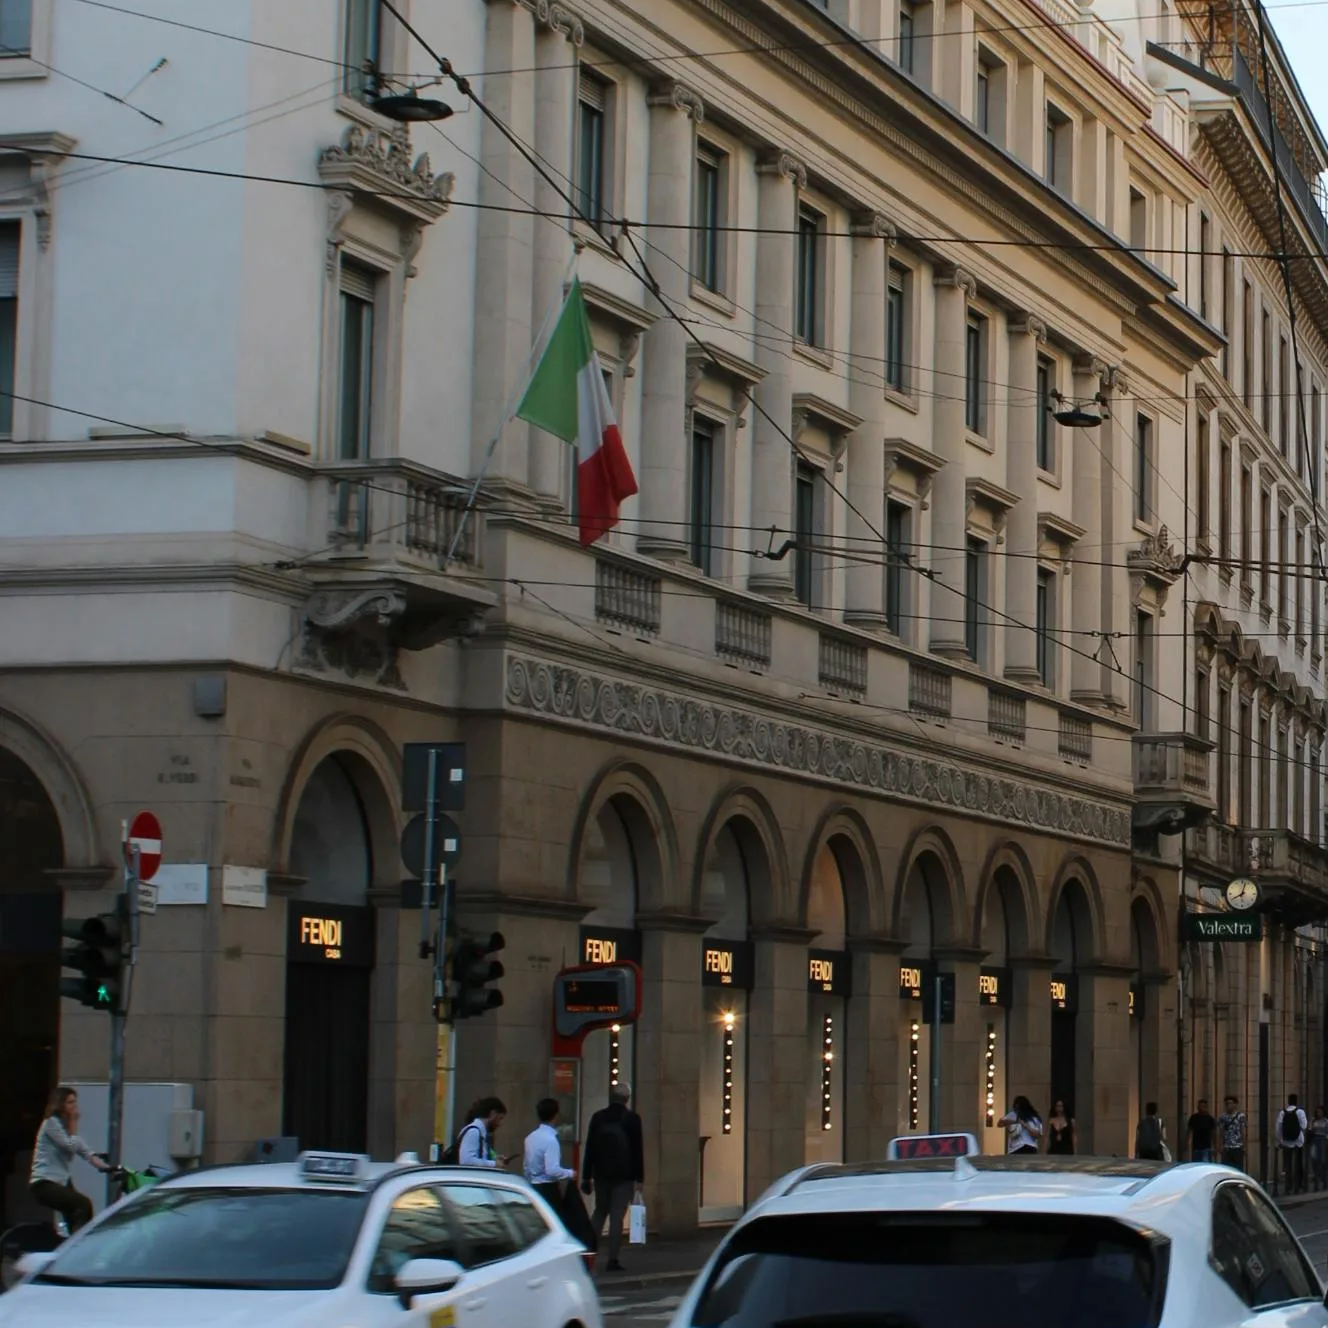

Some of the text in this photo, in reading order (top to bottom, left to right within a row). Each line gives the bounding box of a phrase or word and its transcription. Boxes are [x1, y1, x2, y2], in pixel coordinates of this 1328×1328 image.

[301, 917, 342, 946] FENDI
[1198, 920, 1252, 935] Valextra
[585, 939, 617, 963] FENDI
[706, 950, 733, 973] FENDI
[810, 959, 833, 980] FENDI
[900, 967, 921, 988] FENDI
[979, 975, 998, 994] FENDI
[896, 1135, 967, 1159] TAXI
